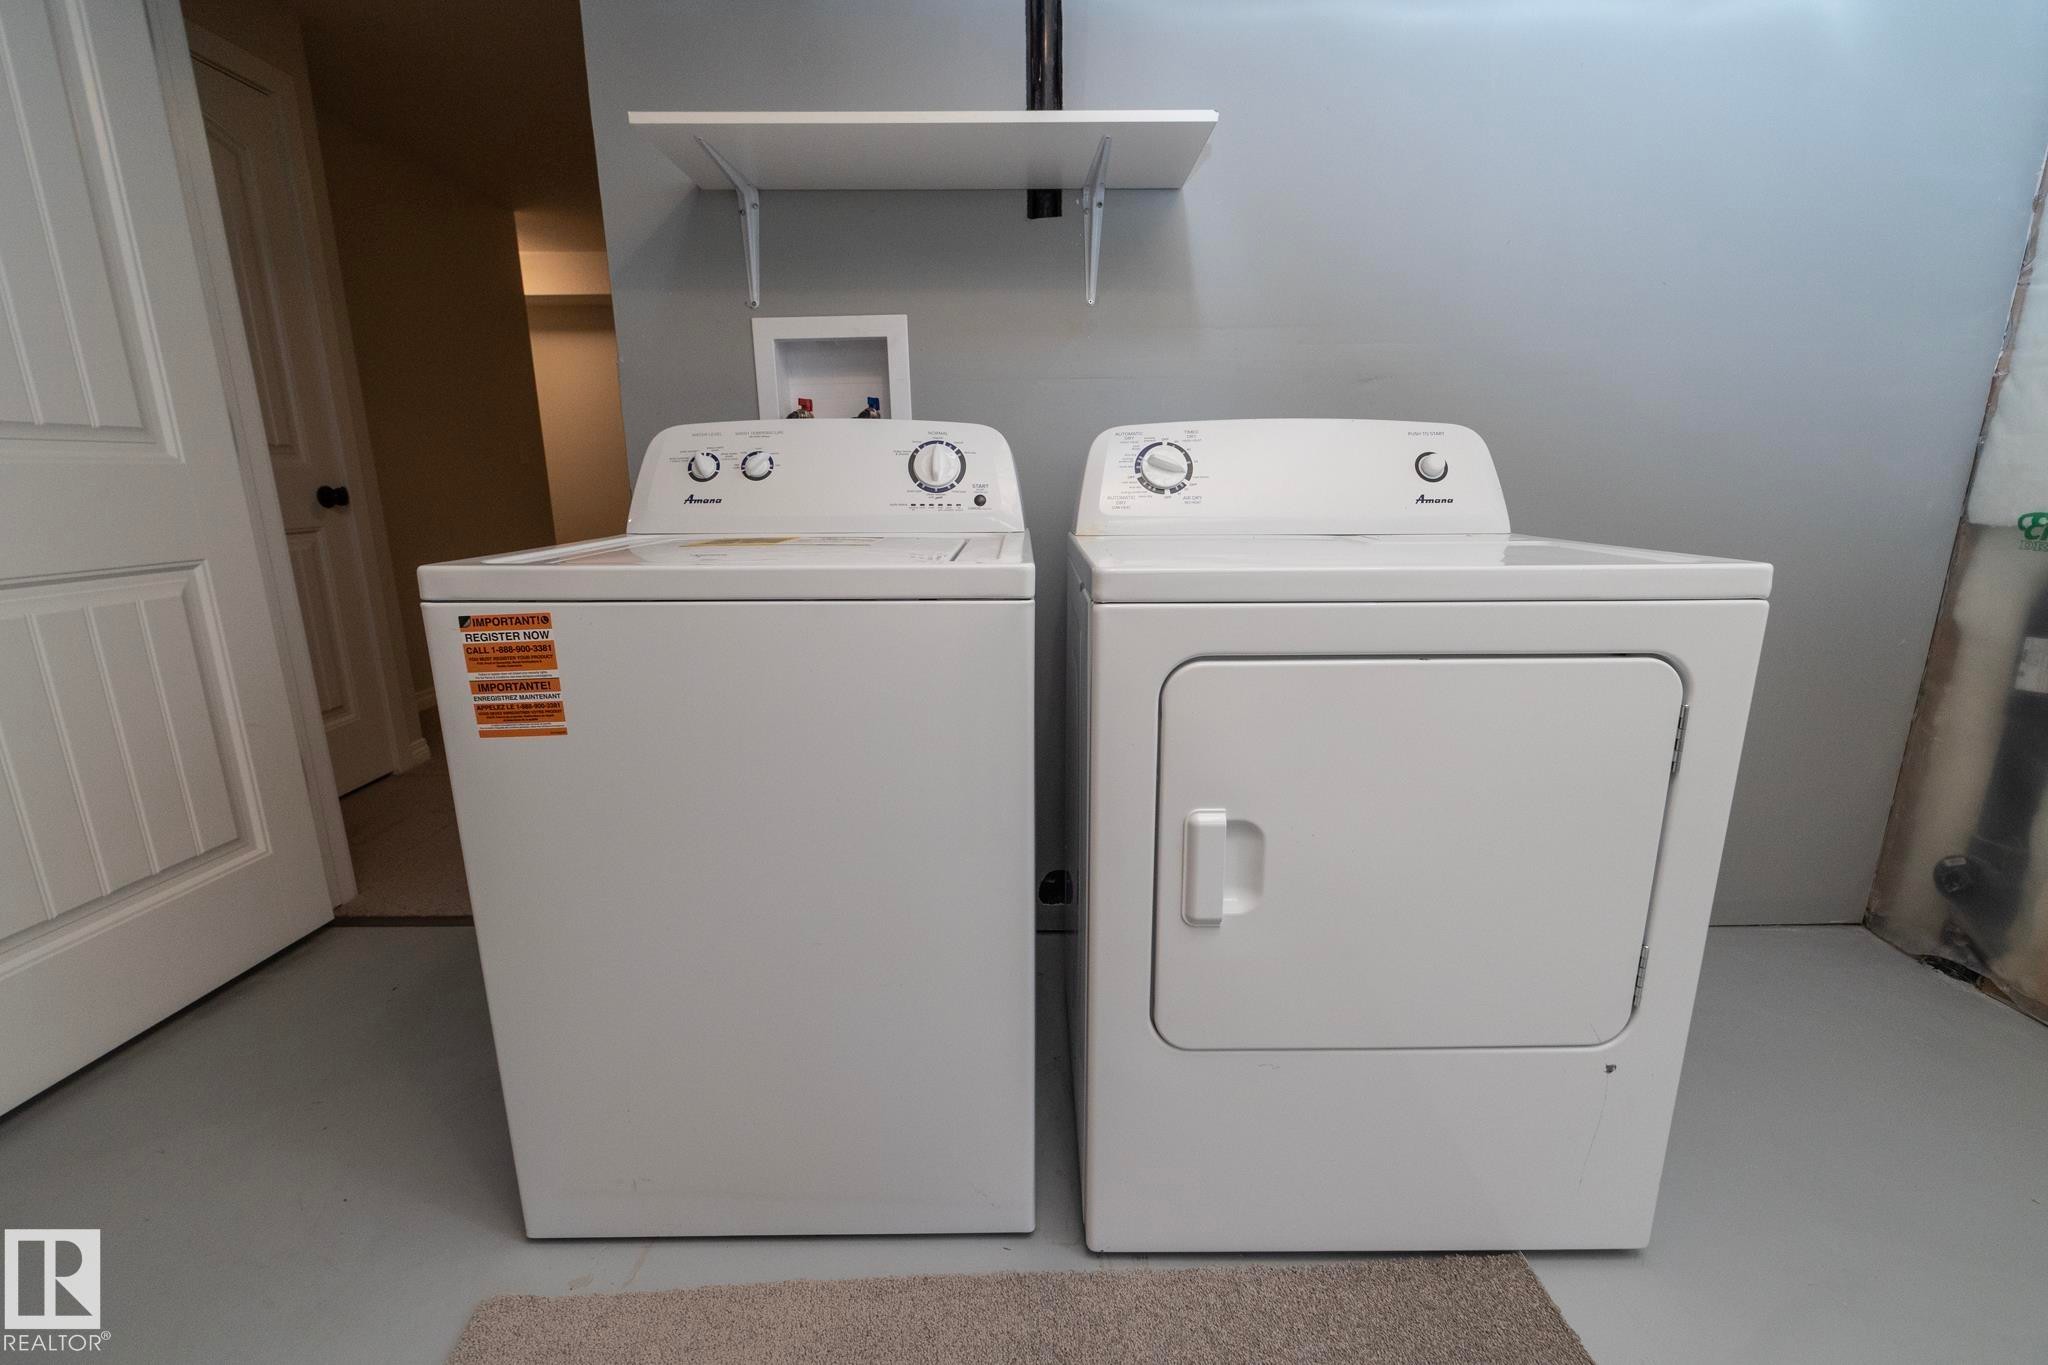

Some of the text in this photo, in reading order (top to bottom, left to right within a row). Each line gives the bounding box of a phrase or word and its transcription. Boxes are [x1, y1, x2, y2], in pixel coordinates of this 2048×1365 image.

[684, 494, 722, 504] Amana
[1415, 494, 1453, 504] Amana
[472, 615, 540, 627] IMPORTANT!
[465, 630, 550, 642] REGISTER NOW
[466, 644, 552, 655] CALL 1-888-900-3381
[477, 681, 551, 692] IMPORTANTE!
[519, 693, 561, 701] MAINTENANT
